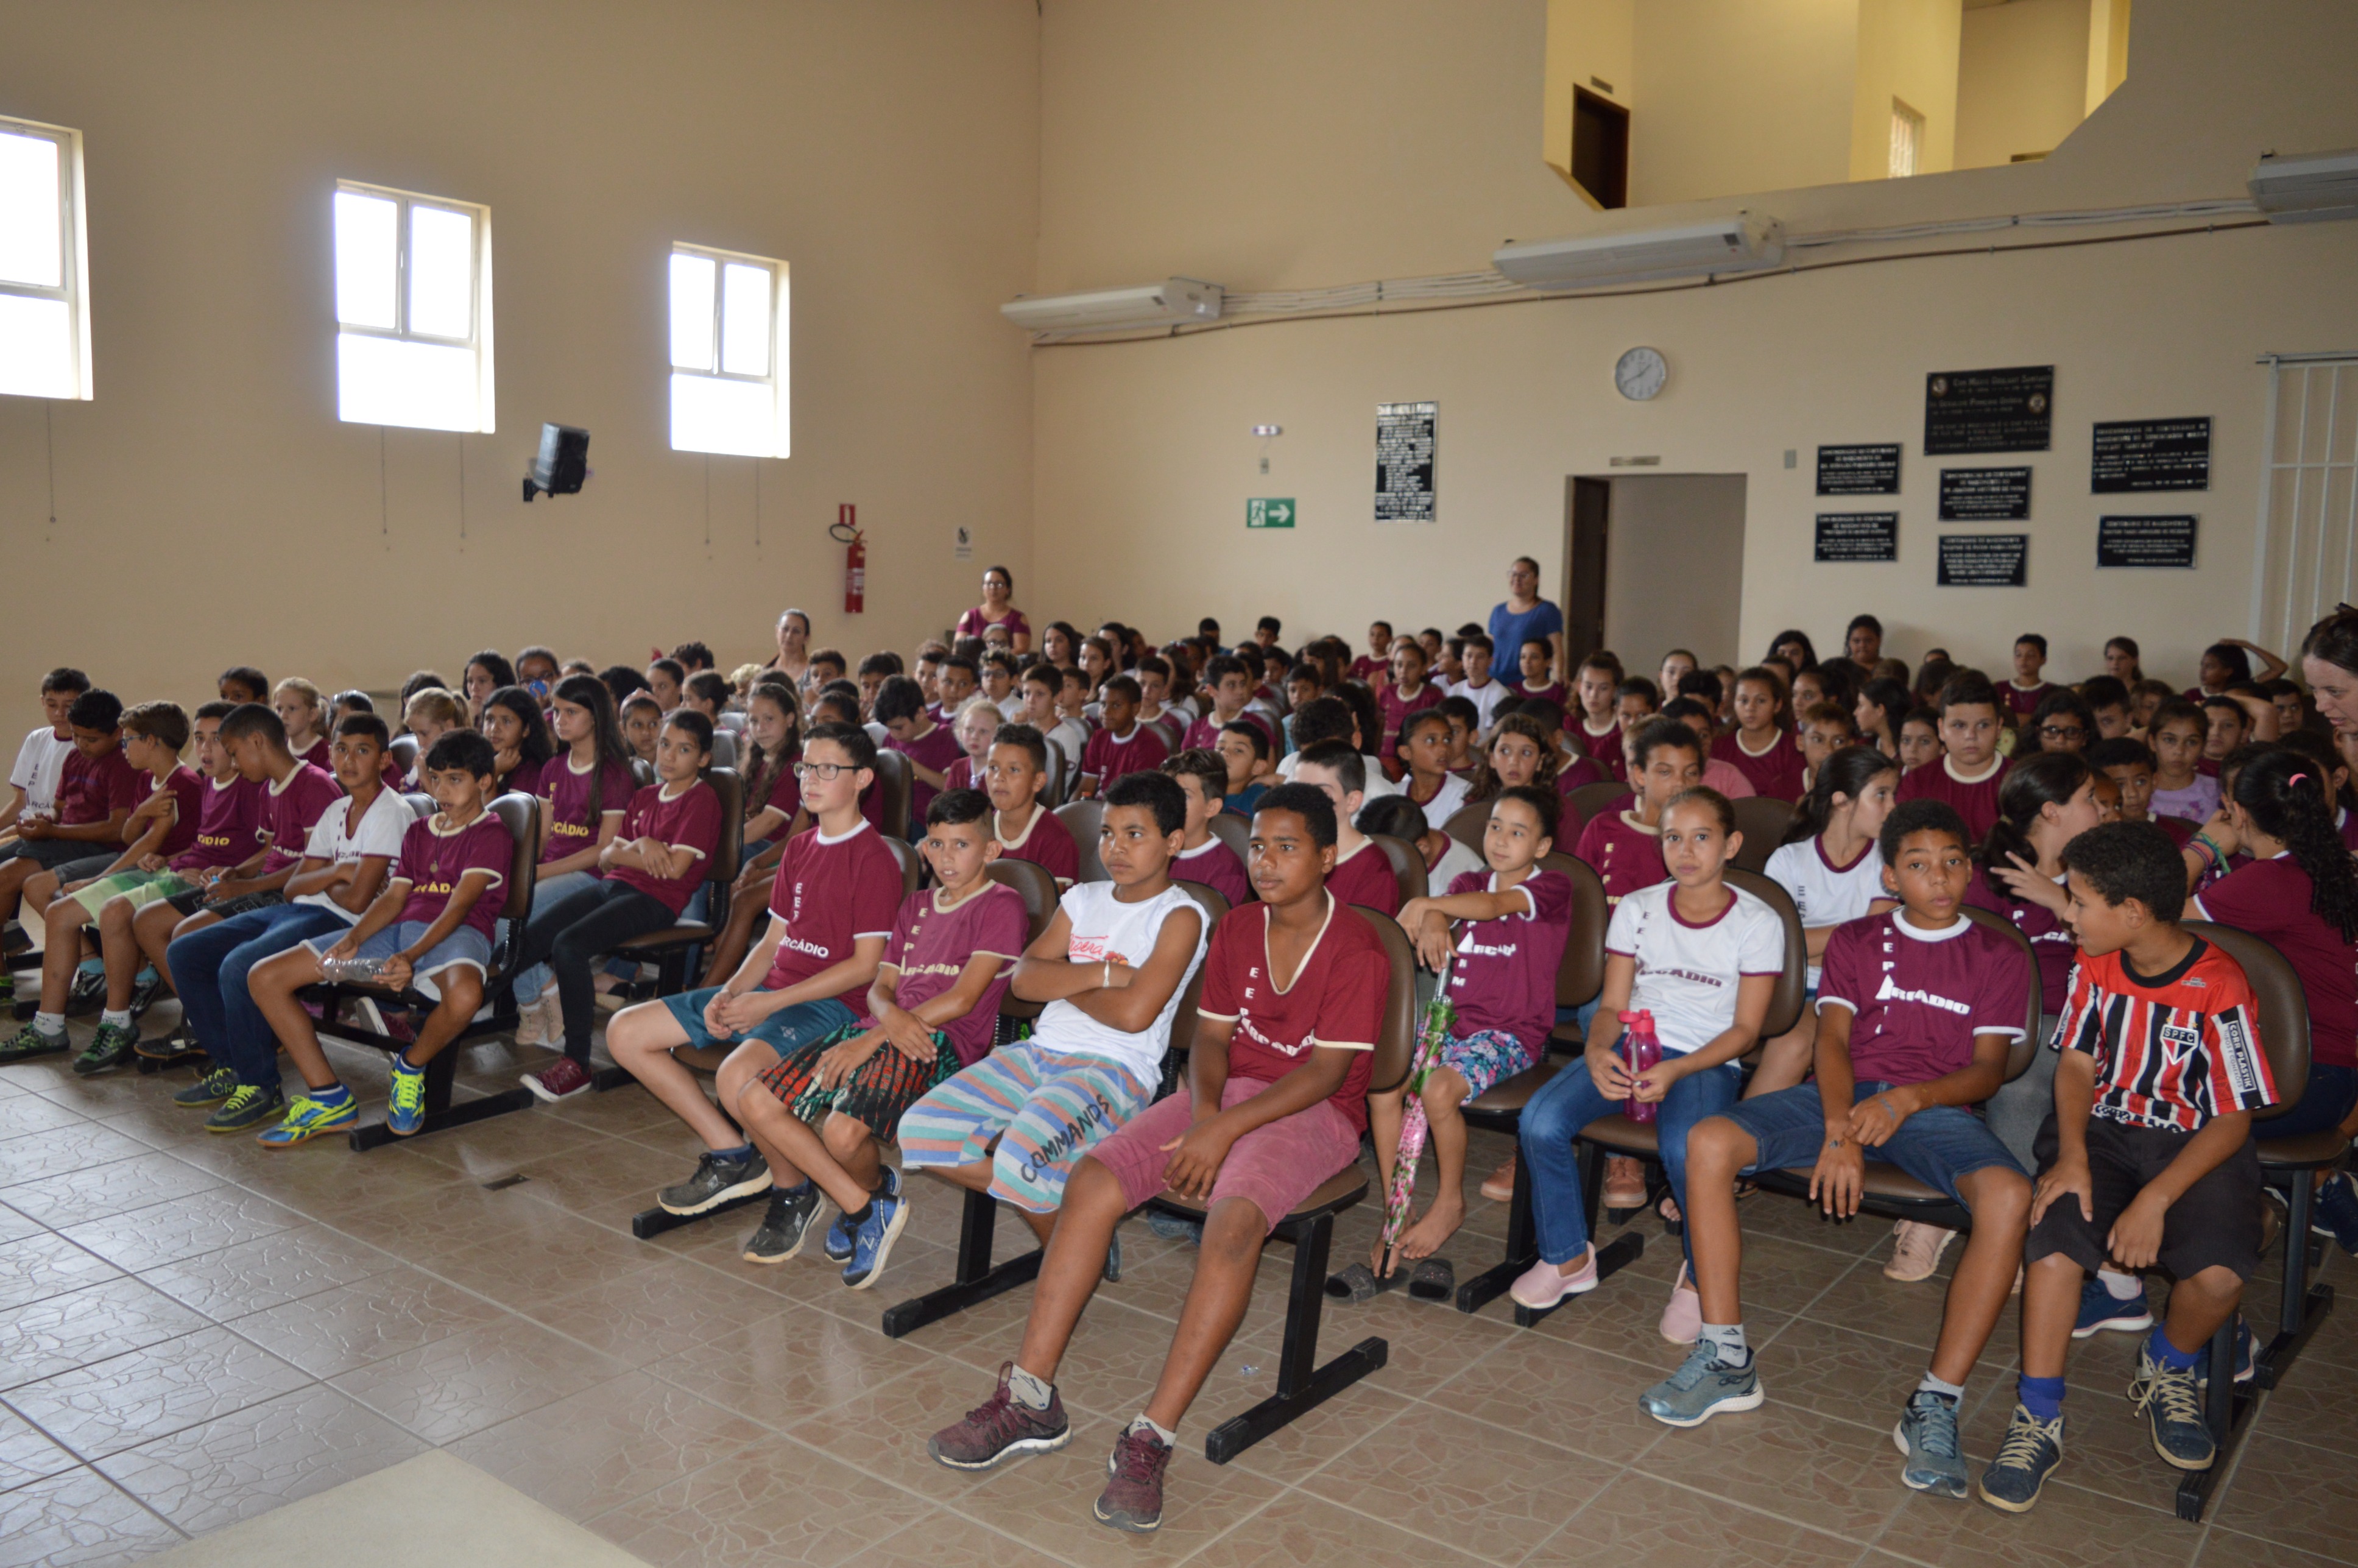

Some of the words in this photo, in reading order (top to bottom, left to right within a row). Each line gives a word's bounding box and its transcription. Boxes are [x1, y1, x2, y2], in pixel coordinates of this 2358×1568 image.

[551, 821, 589, 837] CÁDIO
[2164, 1028, 2194, 1042] SPFC
[2228, 1023, 2242, 1050] CORR
[2236, 1051, 2253, 1089] PLASTIK
[1021, 1094, 1109, 1183] COMMANDS
